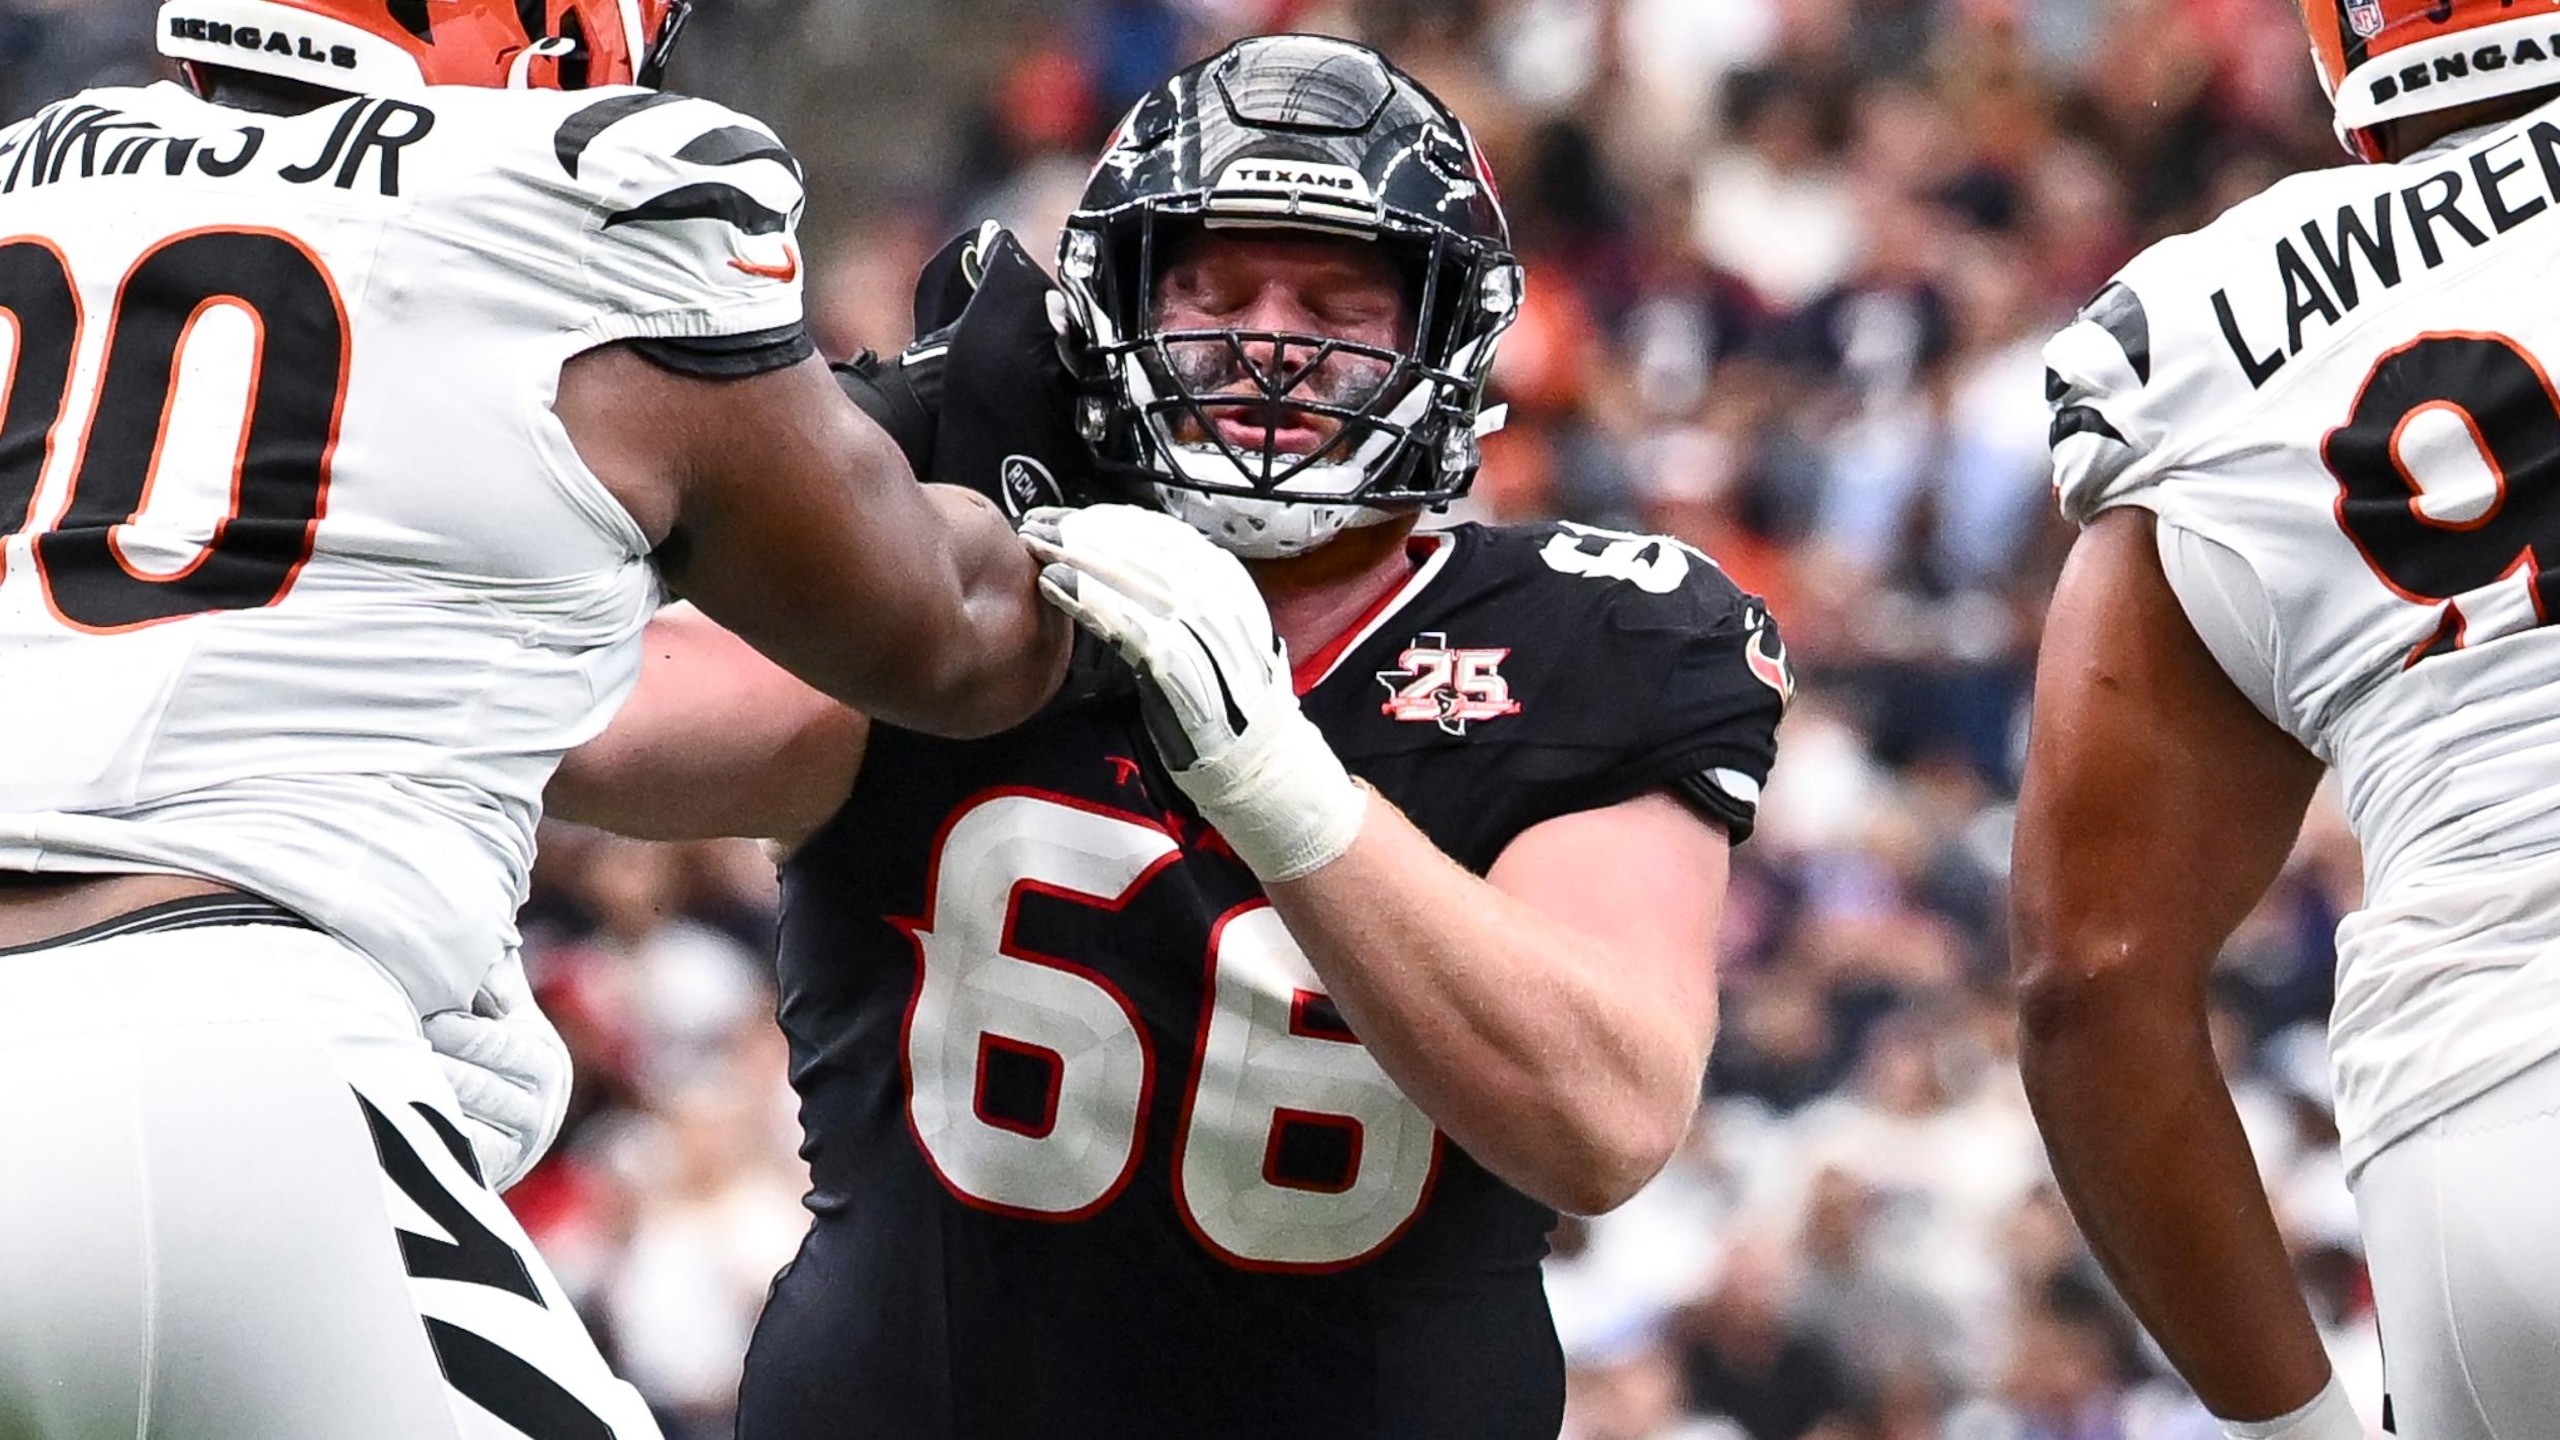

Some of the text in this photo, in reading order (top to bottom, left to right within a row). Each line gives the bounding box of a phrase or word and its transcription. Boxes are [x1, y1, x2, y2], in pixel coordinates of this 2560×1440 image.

[170, 18, 356, 69] BENGALS
[0, 98, 435, 196] NKINS JR
[1237, 169, 1353, 189] TEXANS
[1007, 462, 1038, 504] RCM
[1398, 648, 1511, 703] 25
[884, 785, 1447, 1273] 66
